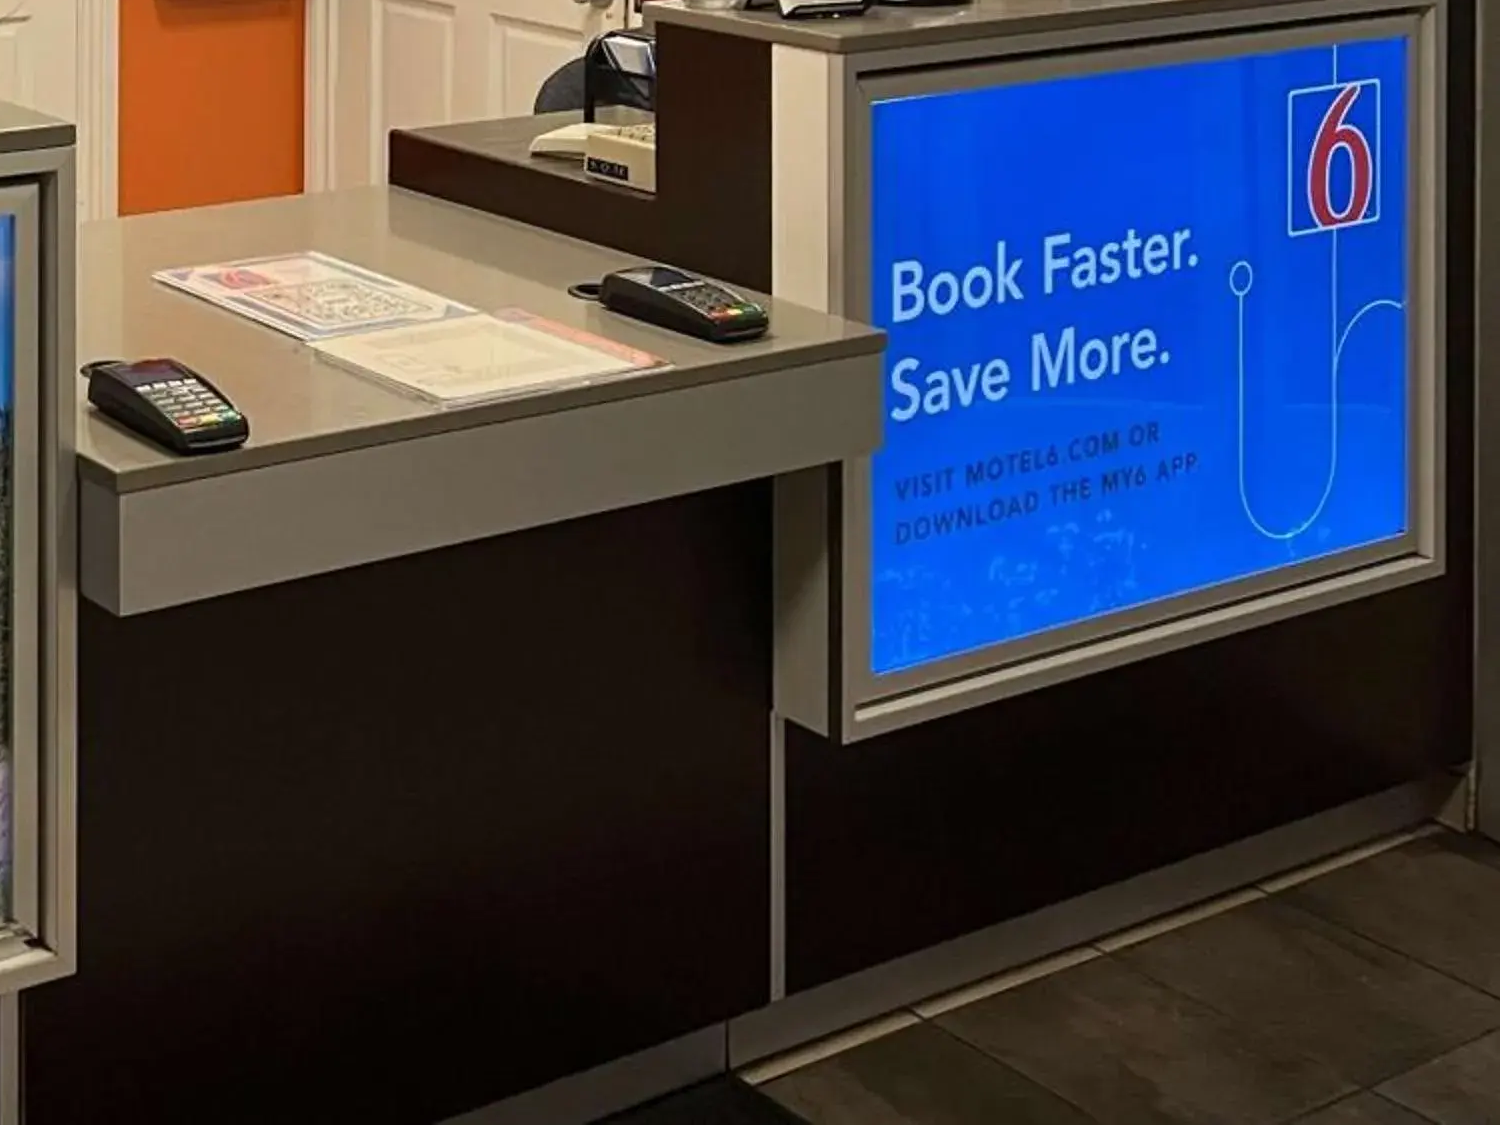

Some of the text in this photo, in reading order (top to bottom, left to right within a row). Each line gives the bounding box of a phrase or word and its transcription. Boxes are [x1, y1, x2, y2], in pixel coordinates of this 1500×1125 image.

[1307, 82, 1373, 230] 6
[892, 228, 1199, 323] Book Faster.
[890, 326, 1170, 422] Save More.
[895, 421, 1160, 501] VISIT MOTEL6.COM OR
[896, 451, 1198, 546] DOWNLOAD THE MY6 APP
